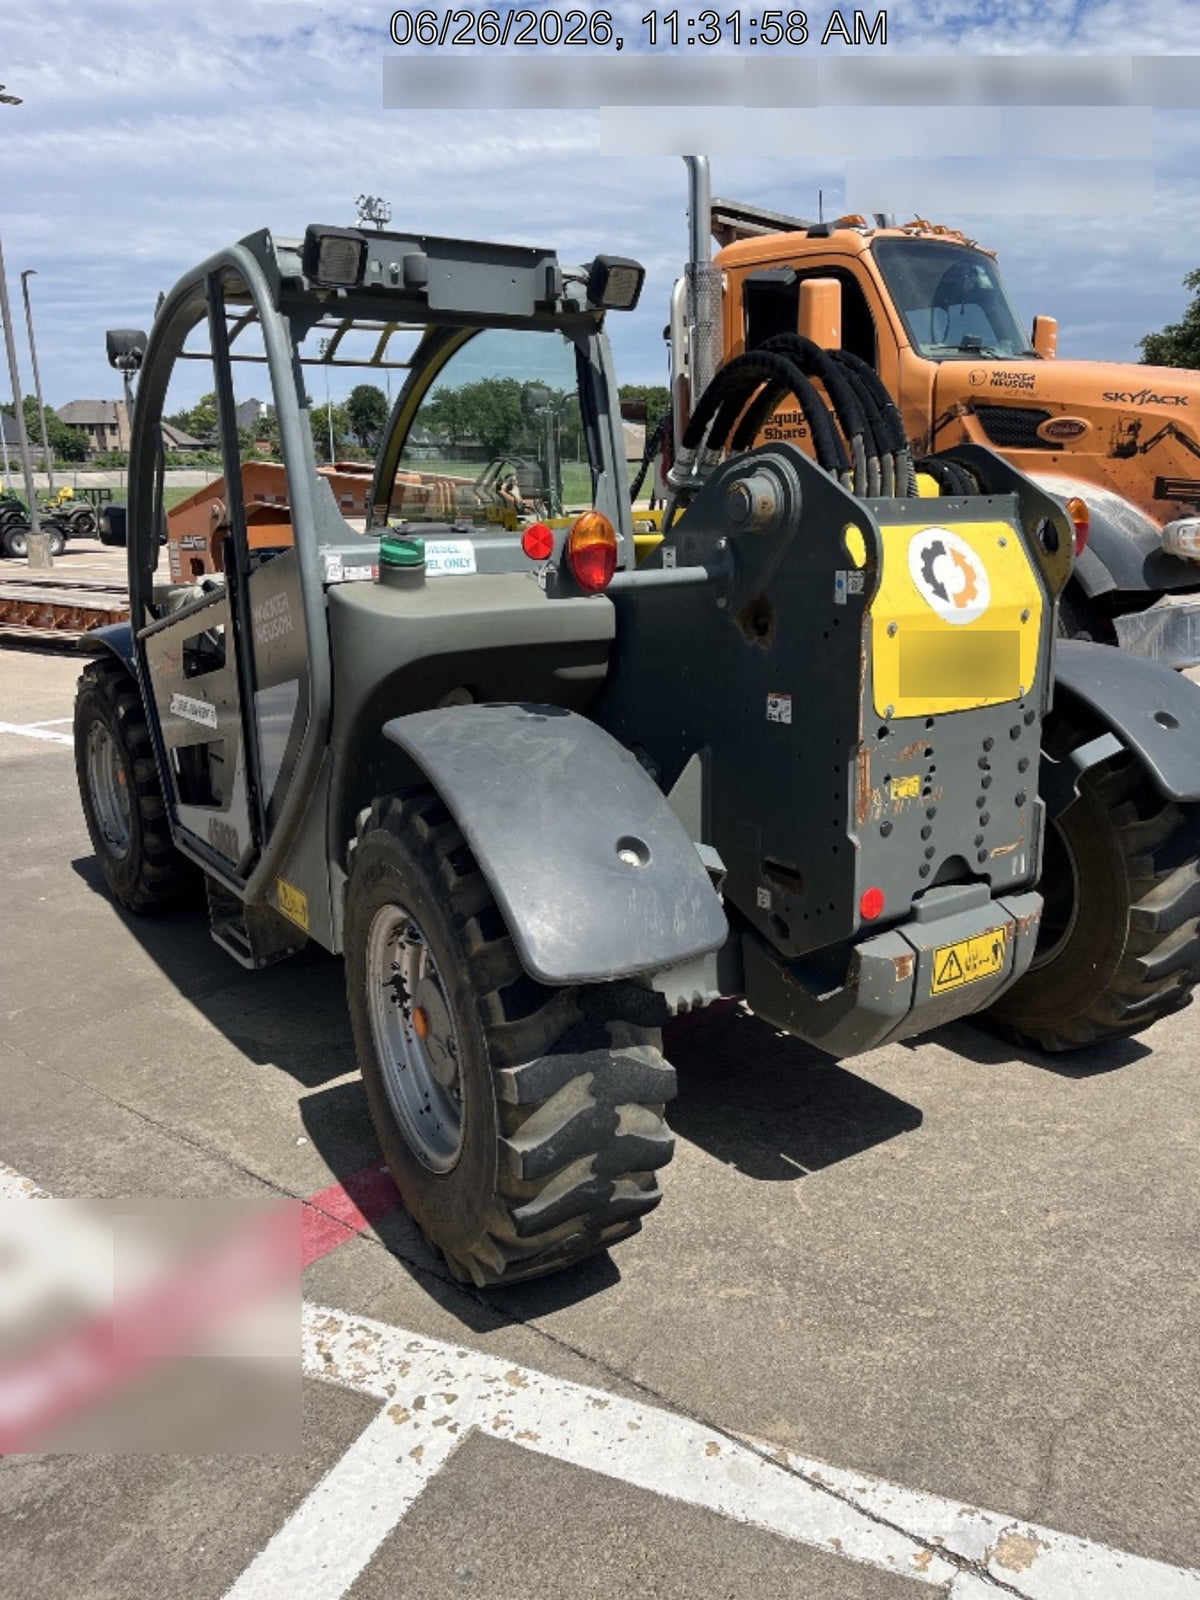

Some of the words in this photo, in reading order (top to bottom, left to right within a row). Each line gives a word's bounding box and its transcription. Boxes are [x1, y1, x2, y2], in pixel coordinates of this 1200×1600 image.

[990, 379, 1036, 389] NEUSON
[1101, 388, 1189, 406] SKYJACK
[764, 428, 807, 440] Share
[444, 557, 472, 569] ONLY
